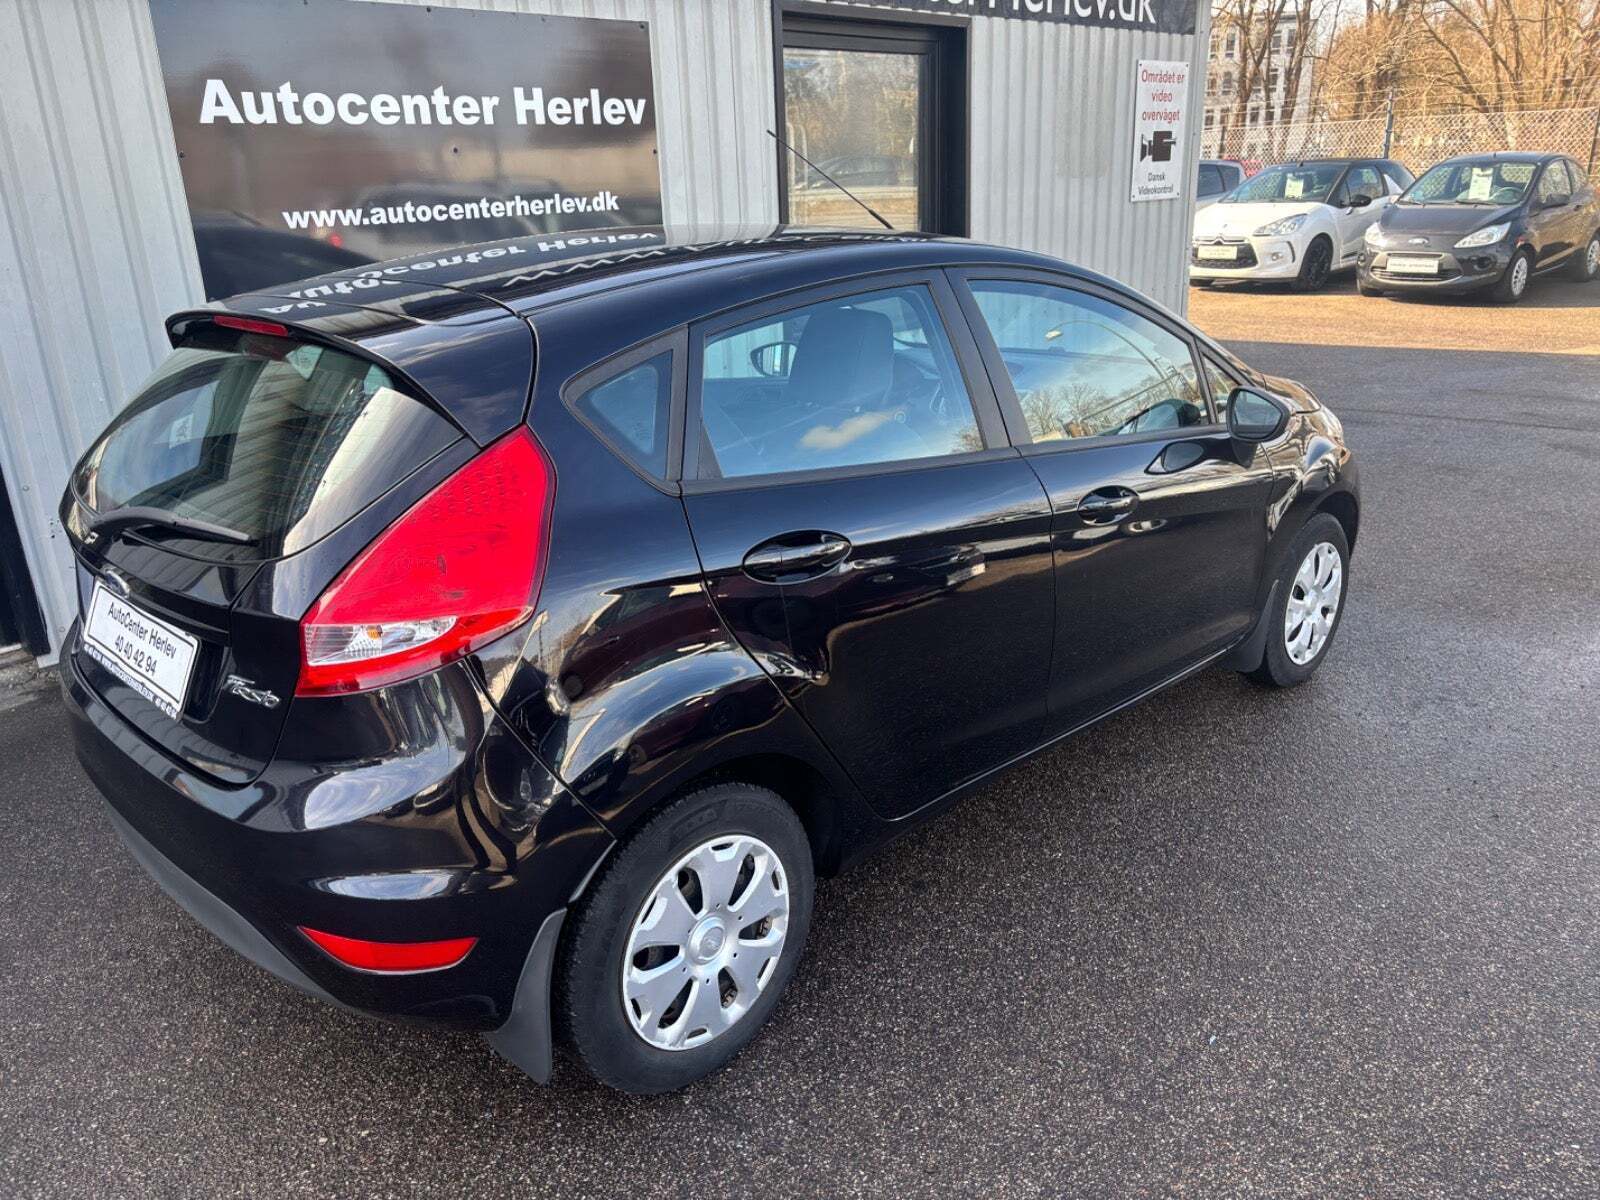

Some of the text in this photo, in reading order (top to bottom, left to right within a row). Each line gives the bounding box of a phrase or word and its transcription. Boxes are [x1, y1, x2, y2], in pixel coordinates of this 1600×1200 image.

[1176, 73, 1185, 84] er
[200, 79, 646, 126] Autocenter Herlev
[1151, 90, 1173, 103] video
[1138, 184, 1174, 196] Videokontrol
[1147, 172, 1165, 182] Dansk
[282, 191, 619, 230] www.autocenterherlev.dk
[108, 601, 149, 641] AutoCenter
[148, 628, 177, 659] Herlev
[115, 635, 124, 653] 40
[124, 641, 133, 660] 40
[133, 648, 145, 669] 42
[145, 655, 157, 676] 94
